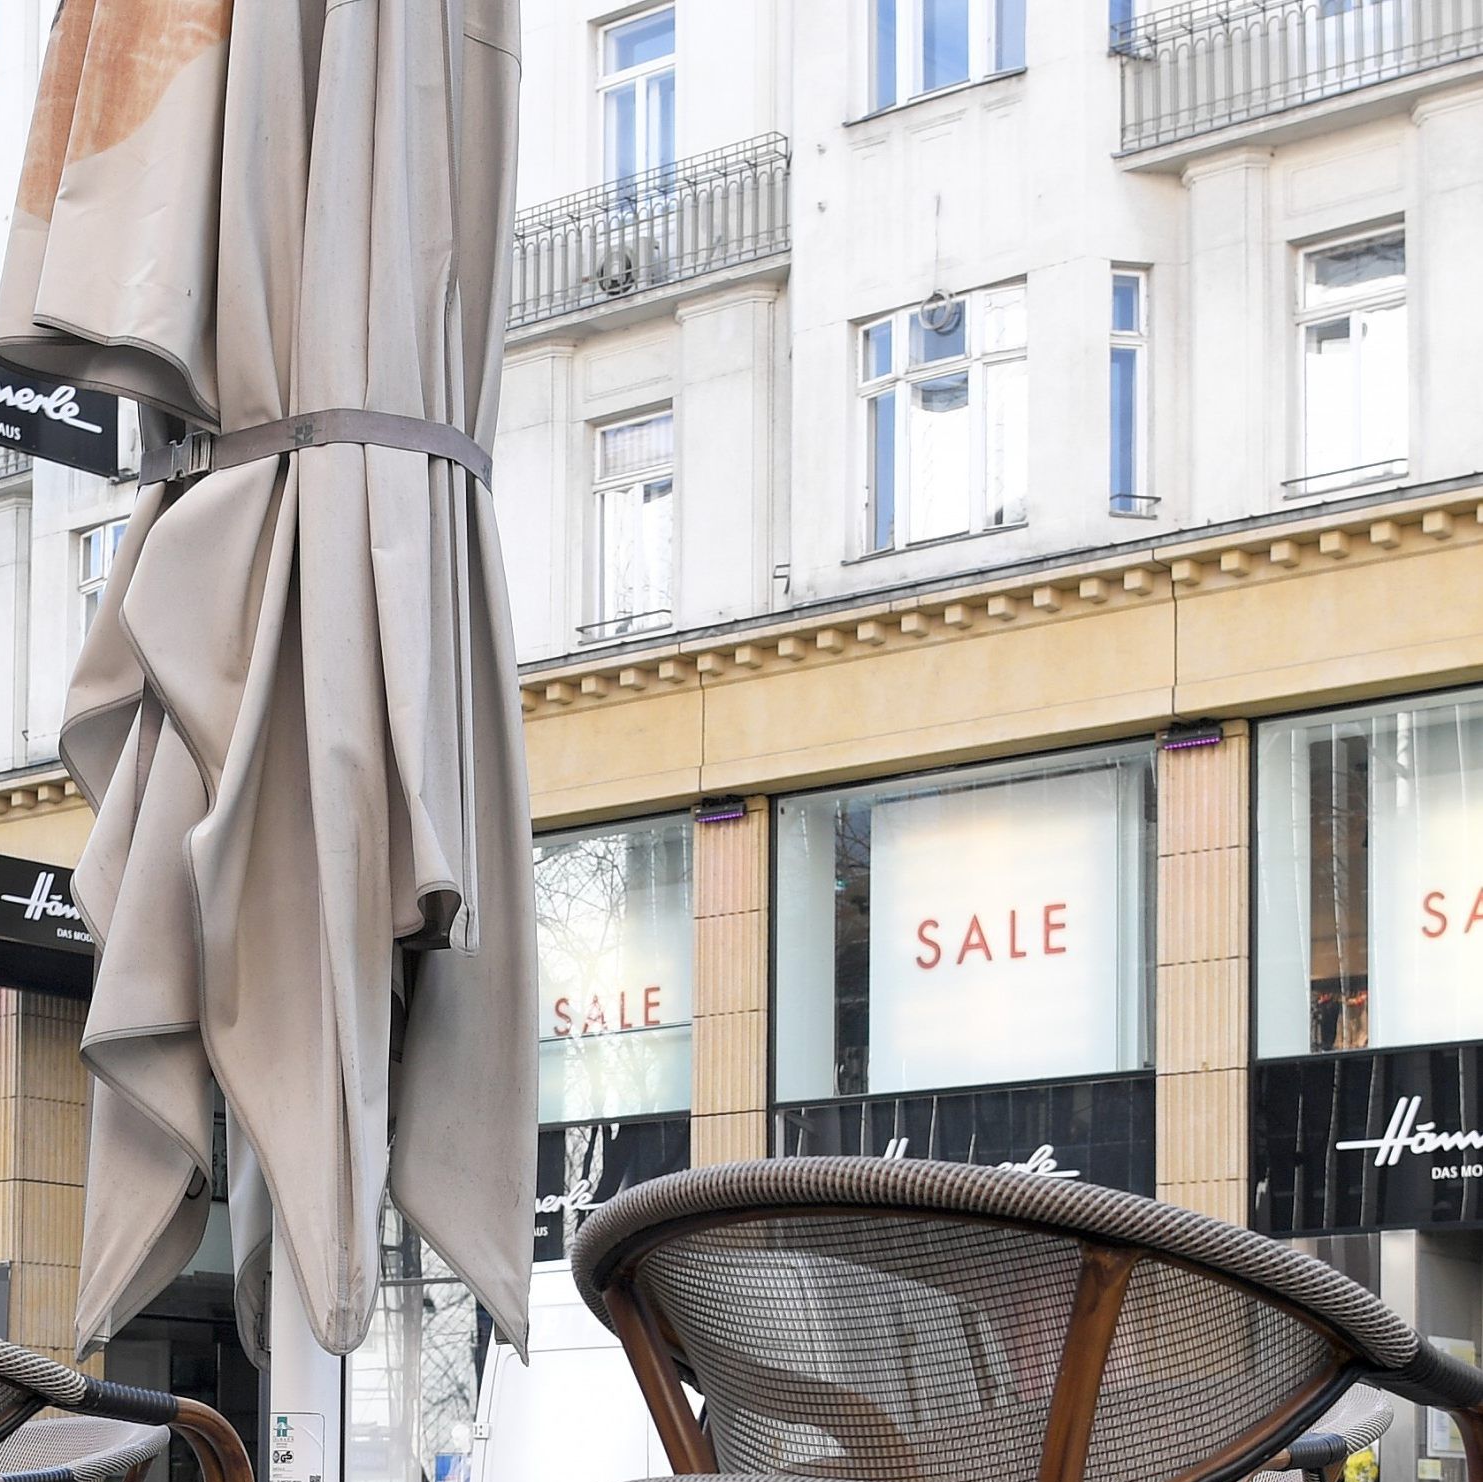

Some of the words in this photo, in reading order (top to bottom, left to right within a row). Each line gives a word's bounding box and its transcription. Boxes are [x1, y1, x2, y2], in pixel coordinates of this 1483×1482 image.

[56, 927, 73, 940] DAS
[915, 904, 1068, 969] SALE
[553, 986, 662, 1037] SALE
[1431, 1166, 1458, 1180] DAS
